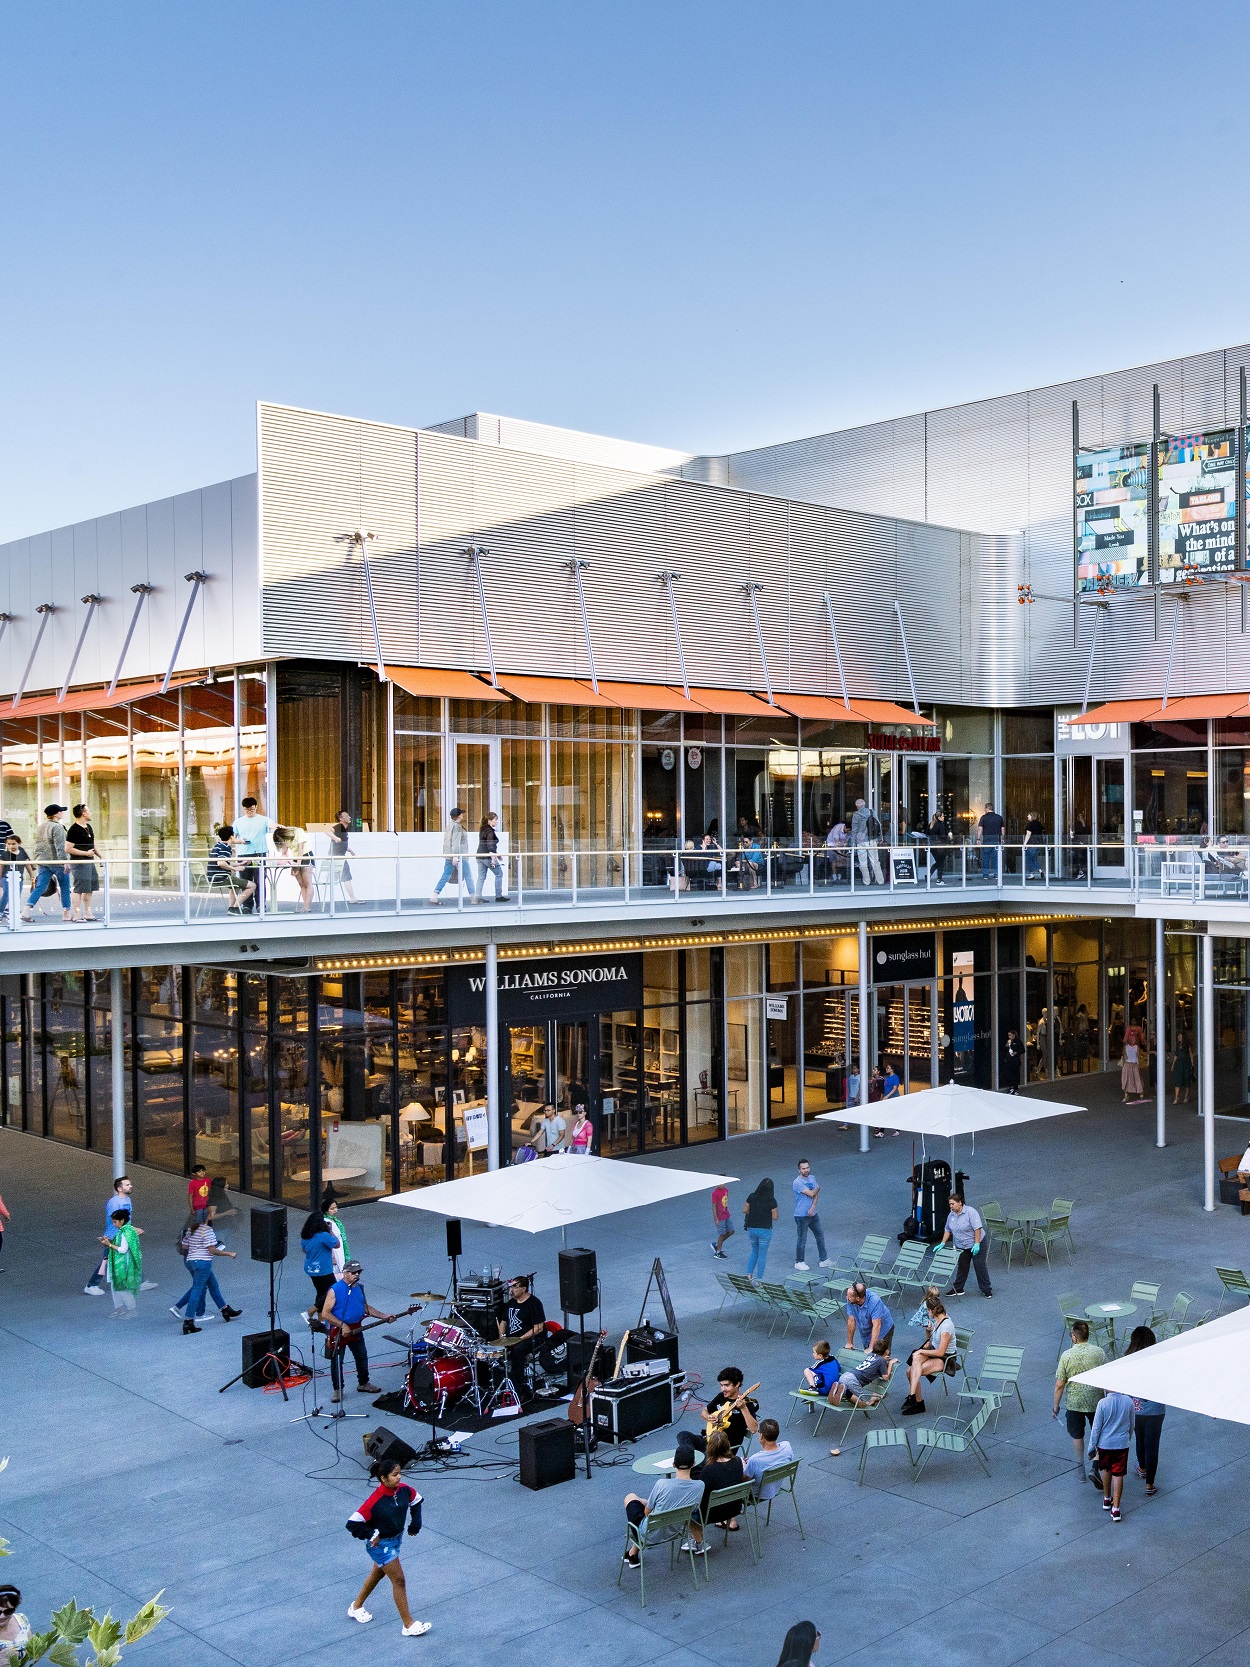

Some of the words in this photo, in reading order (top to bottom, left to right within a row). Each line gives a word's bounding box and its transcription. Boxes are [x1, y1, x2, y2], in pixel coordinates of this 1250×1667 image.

[1179, 520, 1219, 537] What's
[1221, 520, 1235, 531] on
[1185, 537, 1204, 551] the
[1205, 531, 1235, 549] mind
[1214, 548, 1226, 562] of
[1228, 550, 1235, 561] a
[1058, 715, 1069, 740] THE
[888, 950, 919, 963] sunglass
[919, 949, 931, 959] hut
[468, 971, 558, 992] WLLIAMS
[561, 966, 628, 985] SONOMA
[530, 992, 571, 1000] CALIFORNIA
[951, 1031, 980, 1044] sunglass
